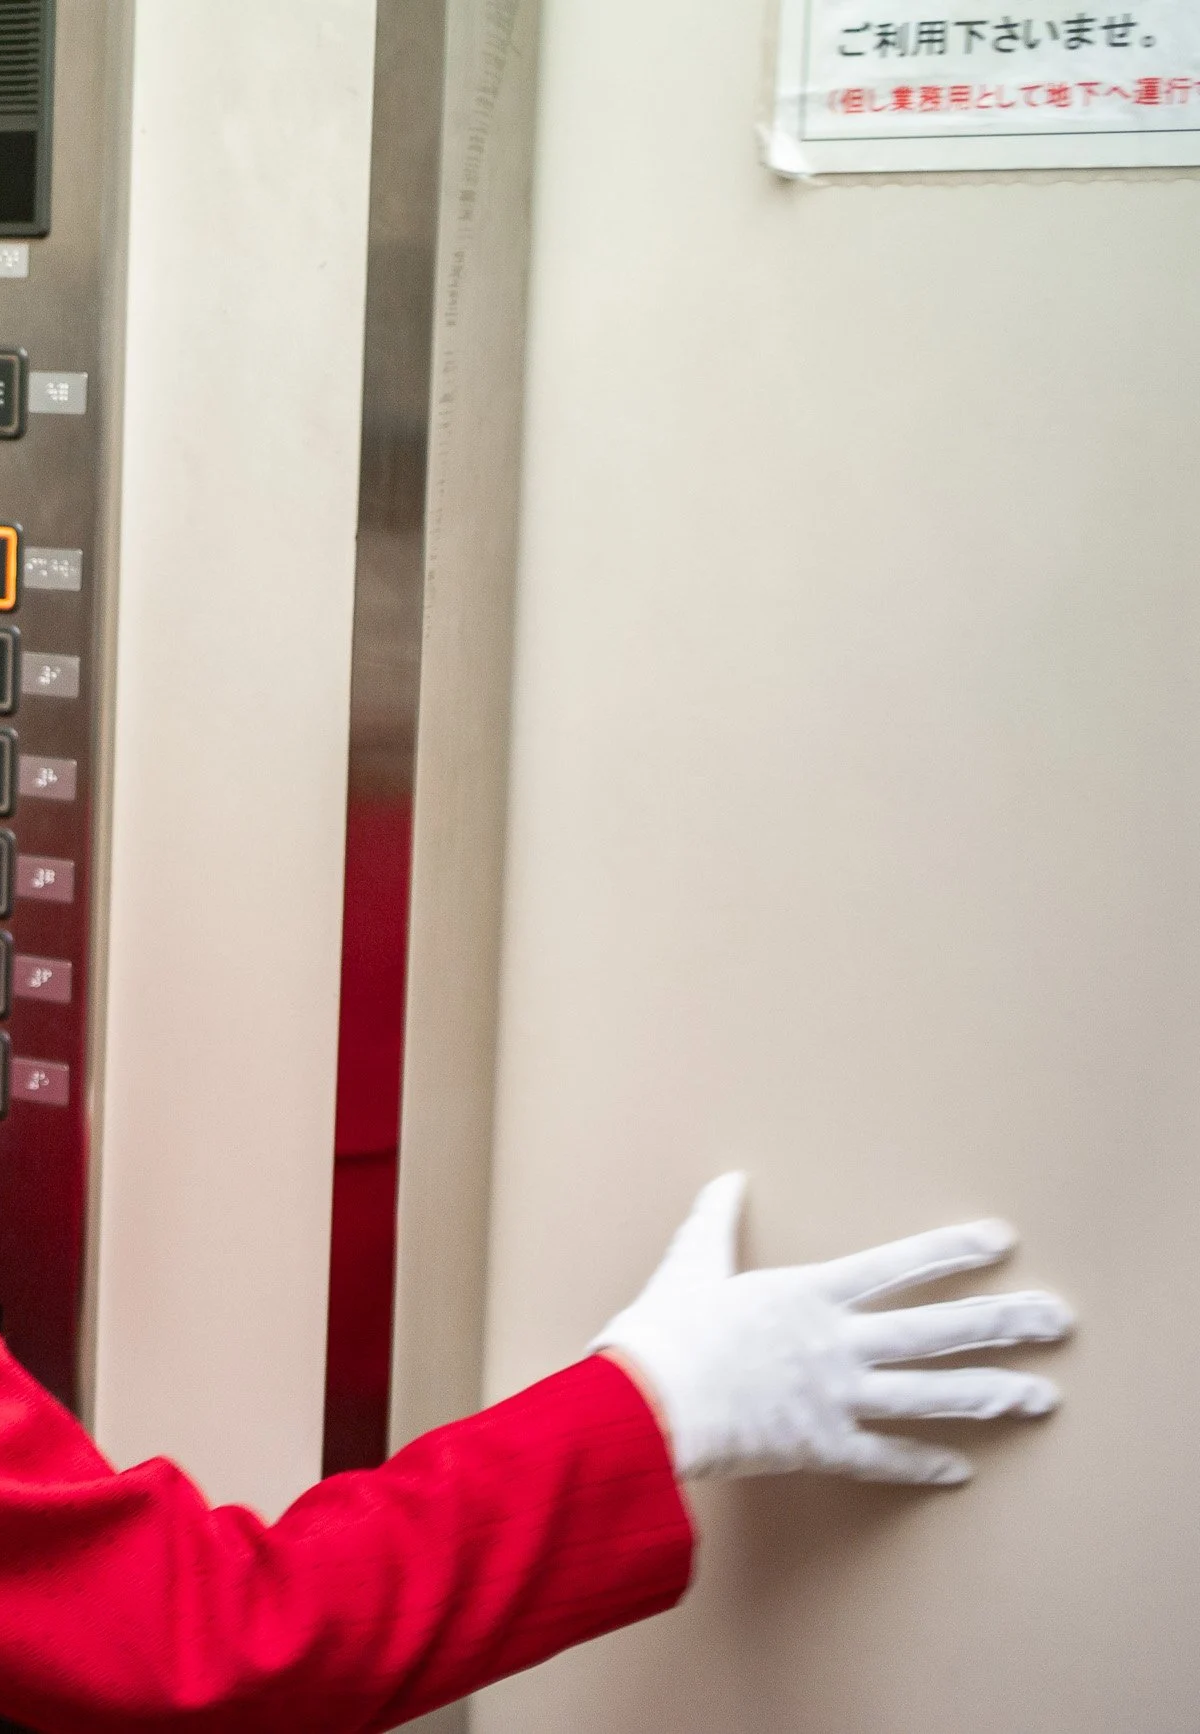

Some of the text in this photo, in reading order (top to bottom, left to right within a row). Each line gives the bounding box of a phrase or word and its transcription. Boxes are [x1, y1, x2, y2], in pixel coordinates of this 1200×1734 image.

[837, 13, 1158, 57] ご利用下さいませ。
[827, 76, 1200, 116] （但し業務用として地下へ運行
